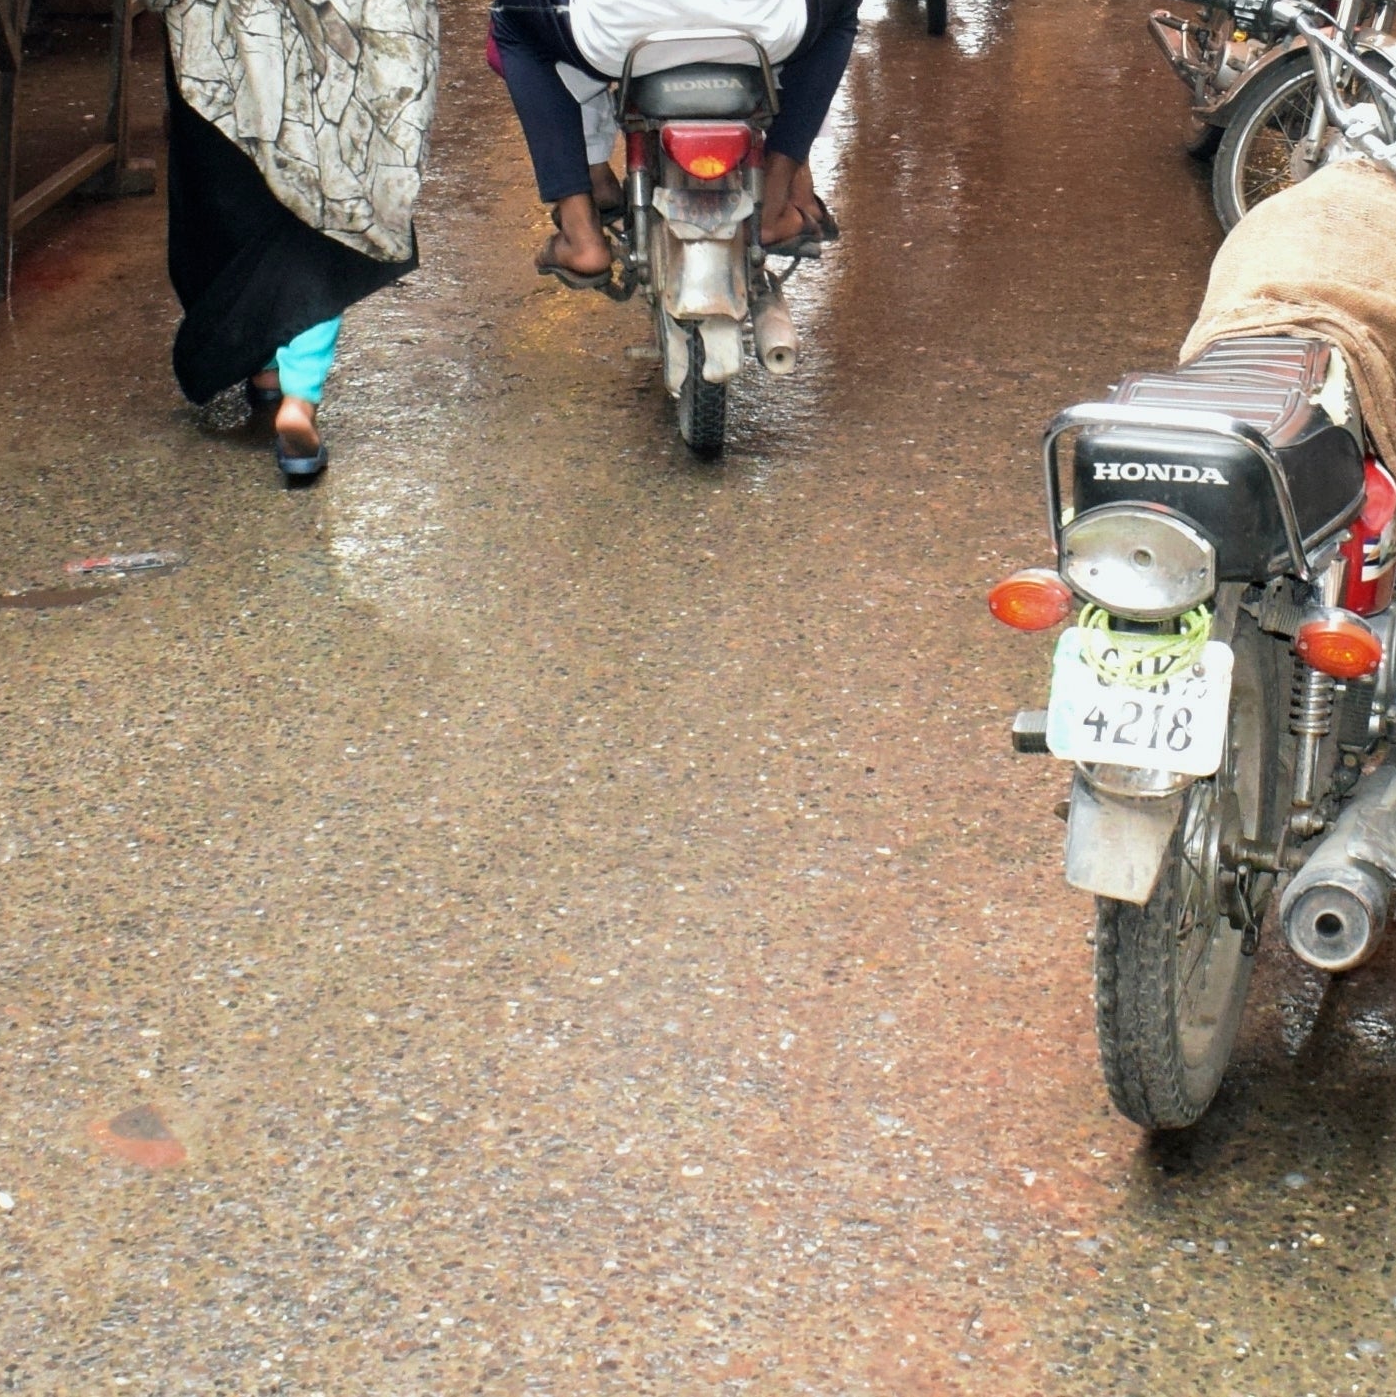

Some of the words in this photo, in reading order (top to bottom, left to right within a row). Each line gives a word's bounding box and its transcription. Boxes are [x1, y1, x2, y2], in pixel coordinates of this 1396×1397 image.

[661, 78, 743, 92] HONDA
[1093, 462, 1229, 486] HONDA
[1083, 701, 1192, 752] 4218
